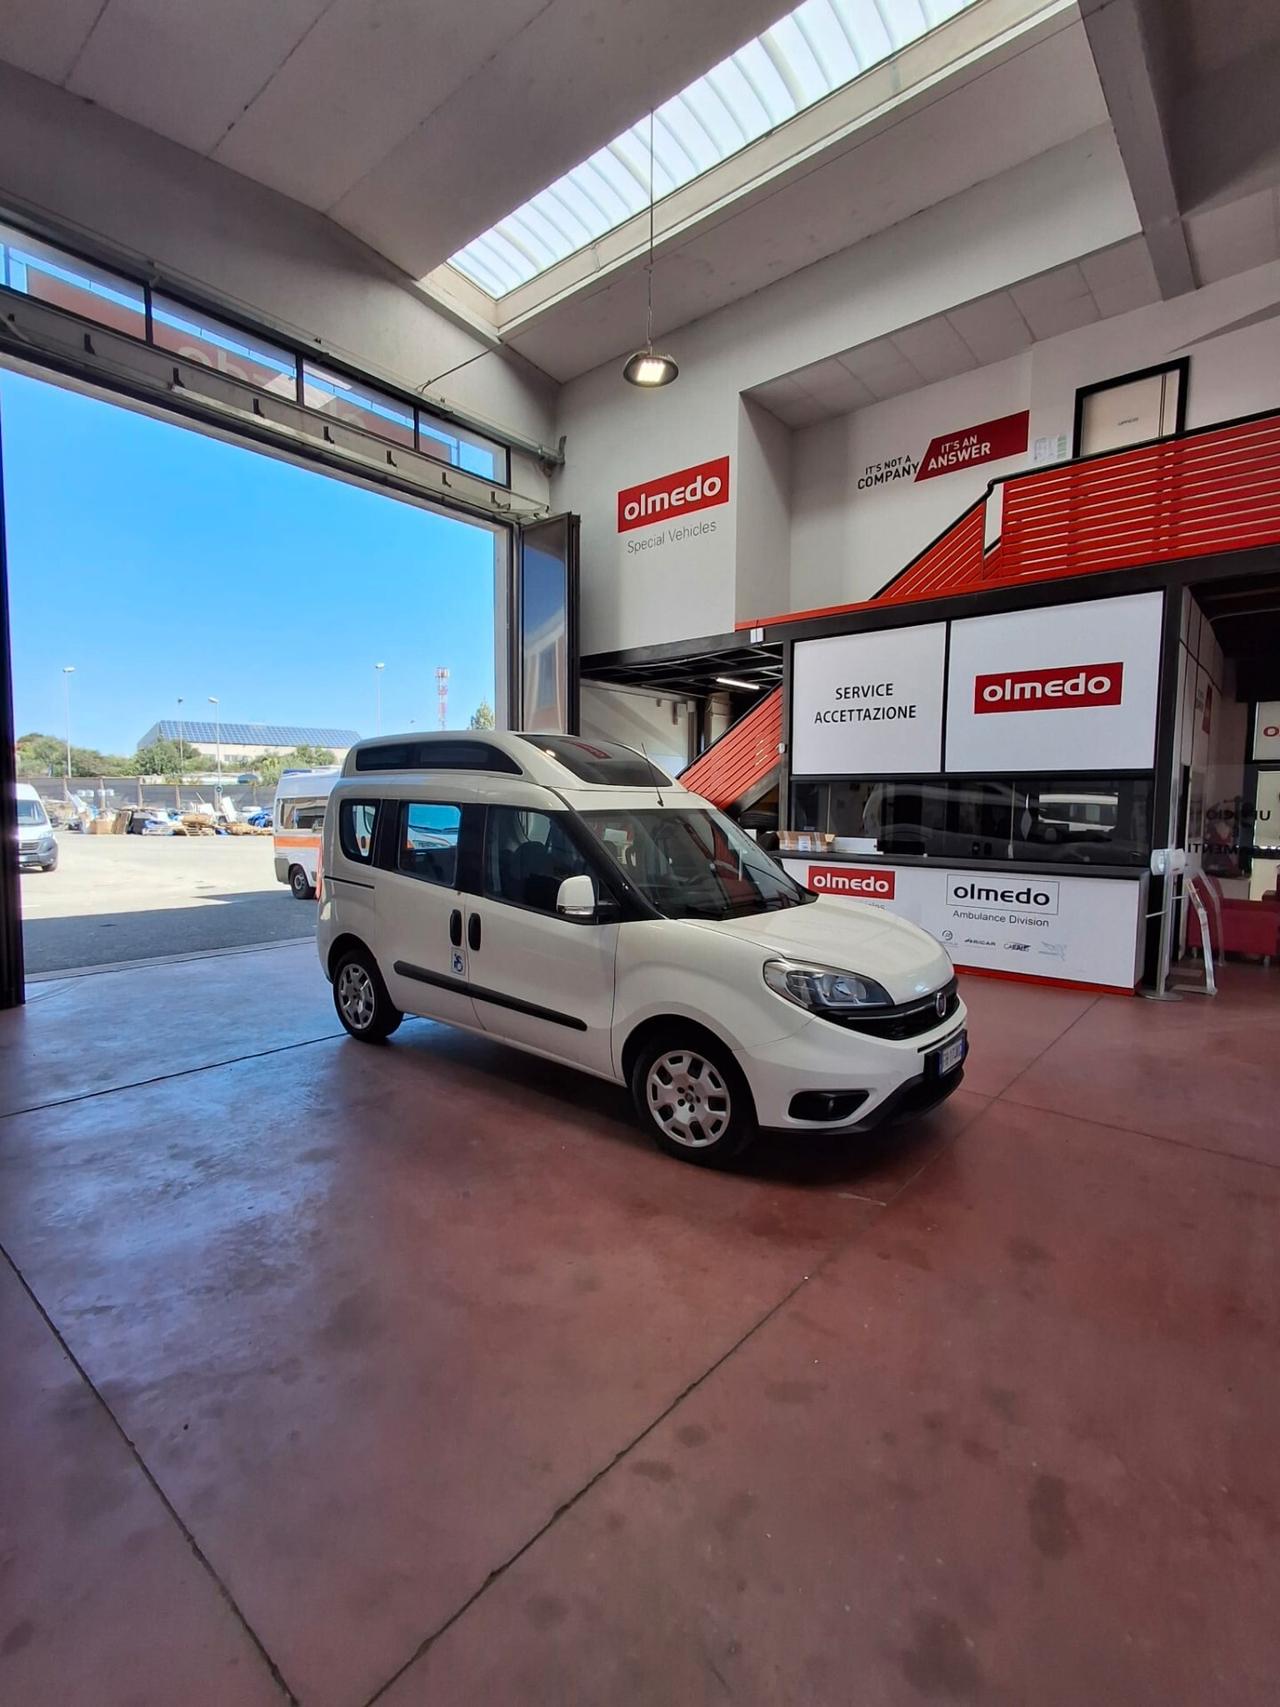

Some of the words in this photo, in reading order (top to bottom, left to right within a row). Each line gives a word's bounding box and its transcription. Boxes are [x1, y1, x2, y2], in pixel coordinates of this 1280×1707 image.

[941, 439, 960, 454] IT'S
[962, 434, 978, 448] AN
[865, 463, 882, 475] IT'S
[884, 457, 903, 470] NOT
[904, 455, 911, 464] A
[928, 442, 991, 471] ANSWER
[857, 461, 920, 490] COMPANY
[624, 474, 722, 521] olmedo
[627, 532, 665, 555] Special
[668, 520, 718, 543] Vehicles
[835, 682, 894, 700] SERVICE
[982, 671, 1112, 702] olmedo
[814, 704, 917, 725] ACCETTAZIONE
[813, 872, 890, 893] olmedo
[953, 883, 1051, 906] olmedo
[952, 909, 1007, 923] Ambulance
[1009, 914, 1050, 928] Division
